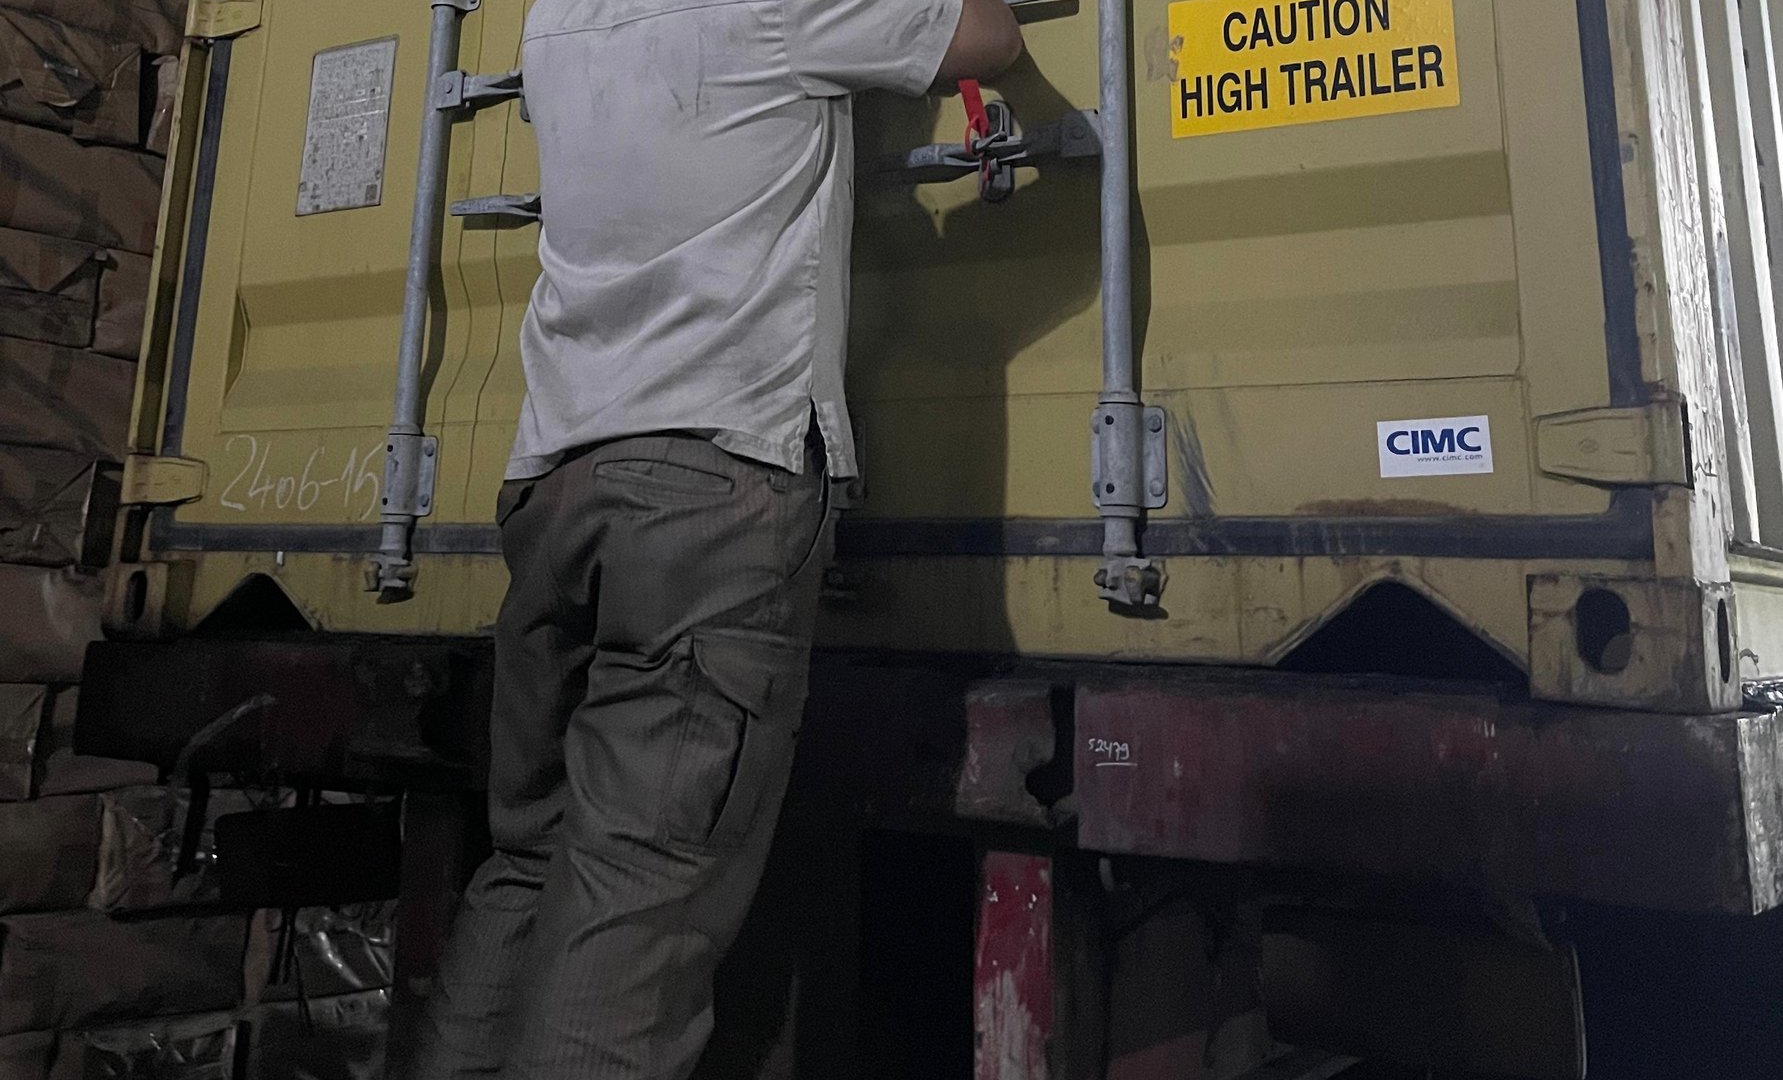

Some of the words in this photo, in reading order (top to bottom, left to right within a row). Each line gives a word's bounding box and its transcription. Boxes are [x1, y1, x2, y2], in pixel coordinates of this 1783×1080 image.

[1180, 67, 1269, 119] HIGH
[1280, 44, 1445, 106] TRAILER
[220, 434, 385, 522] 2406-15
[1386, 426, 1482, 456] CIMC
